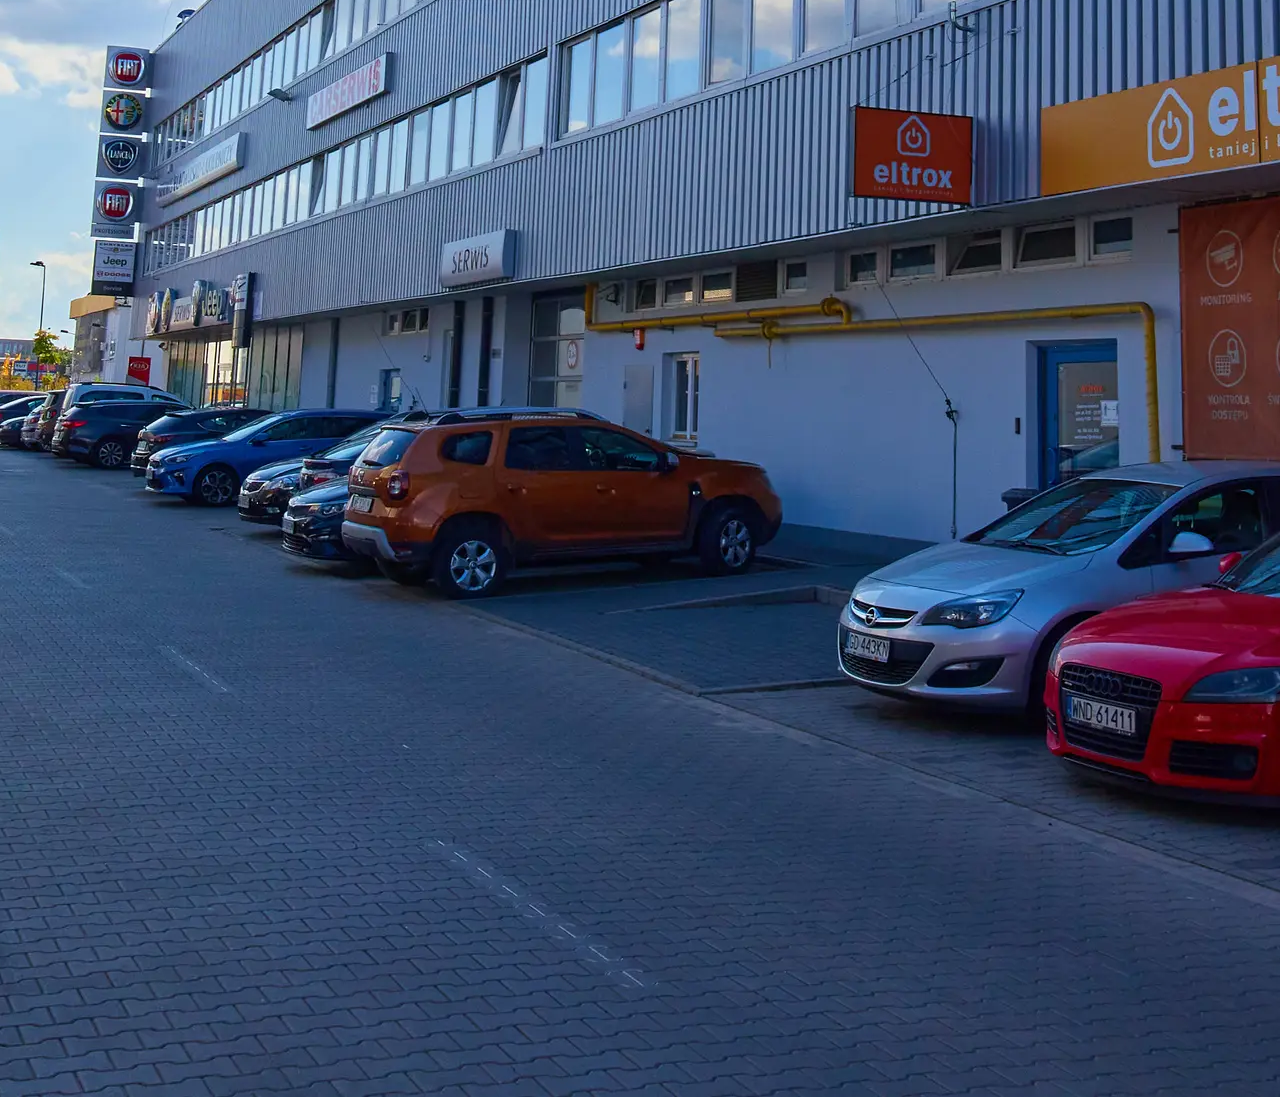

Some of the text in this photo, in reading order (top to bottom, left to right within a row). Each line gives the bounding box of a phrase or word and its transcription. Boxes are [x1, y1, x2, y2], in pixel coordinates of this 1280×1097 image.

[117, 58, 139, 76] FIAT
[310, 58, 381, 125] CARSERWIS
[1209, 140, 1256, 159] taniej
[1263, 136, 1269, 150] i
[873, 161, 952, 189] eltrox
[105, 193, 128, 212] FIAT
[103, 255, 128, 268] Jeep
[451, 244, 489, 275] SERWIS
[1200, 293, 1253, 306] MONITORING
[1207, 395, 1251, 405] KONTROLA
[861, 637, 888, 657] 443KN
[1072, 697, 1133, 732] WND 61411
